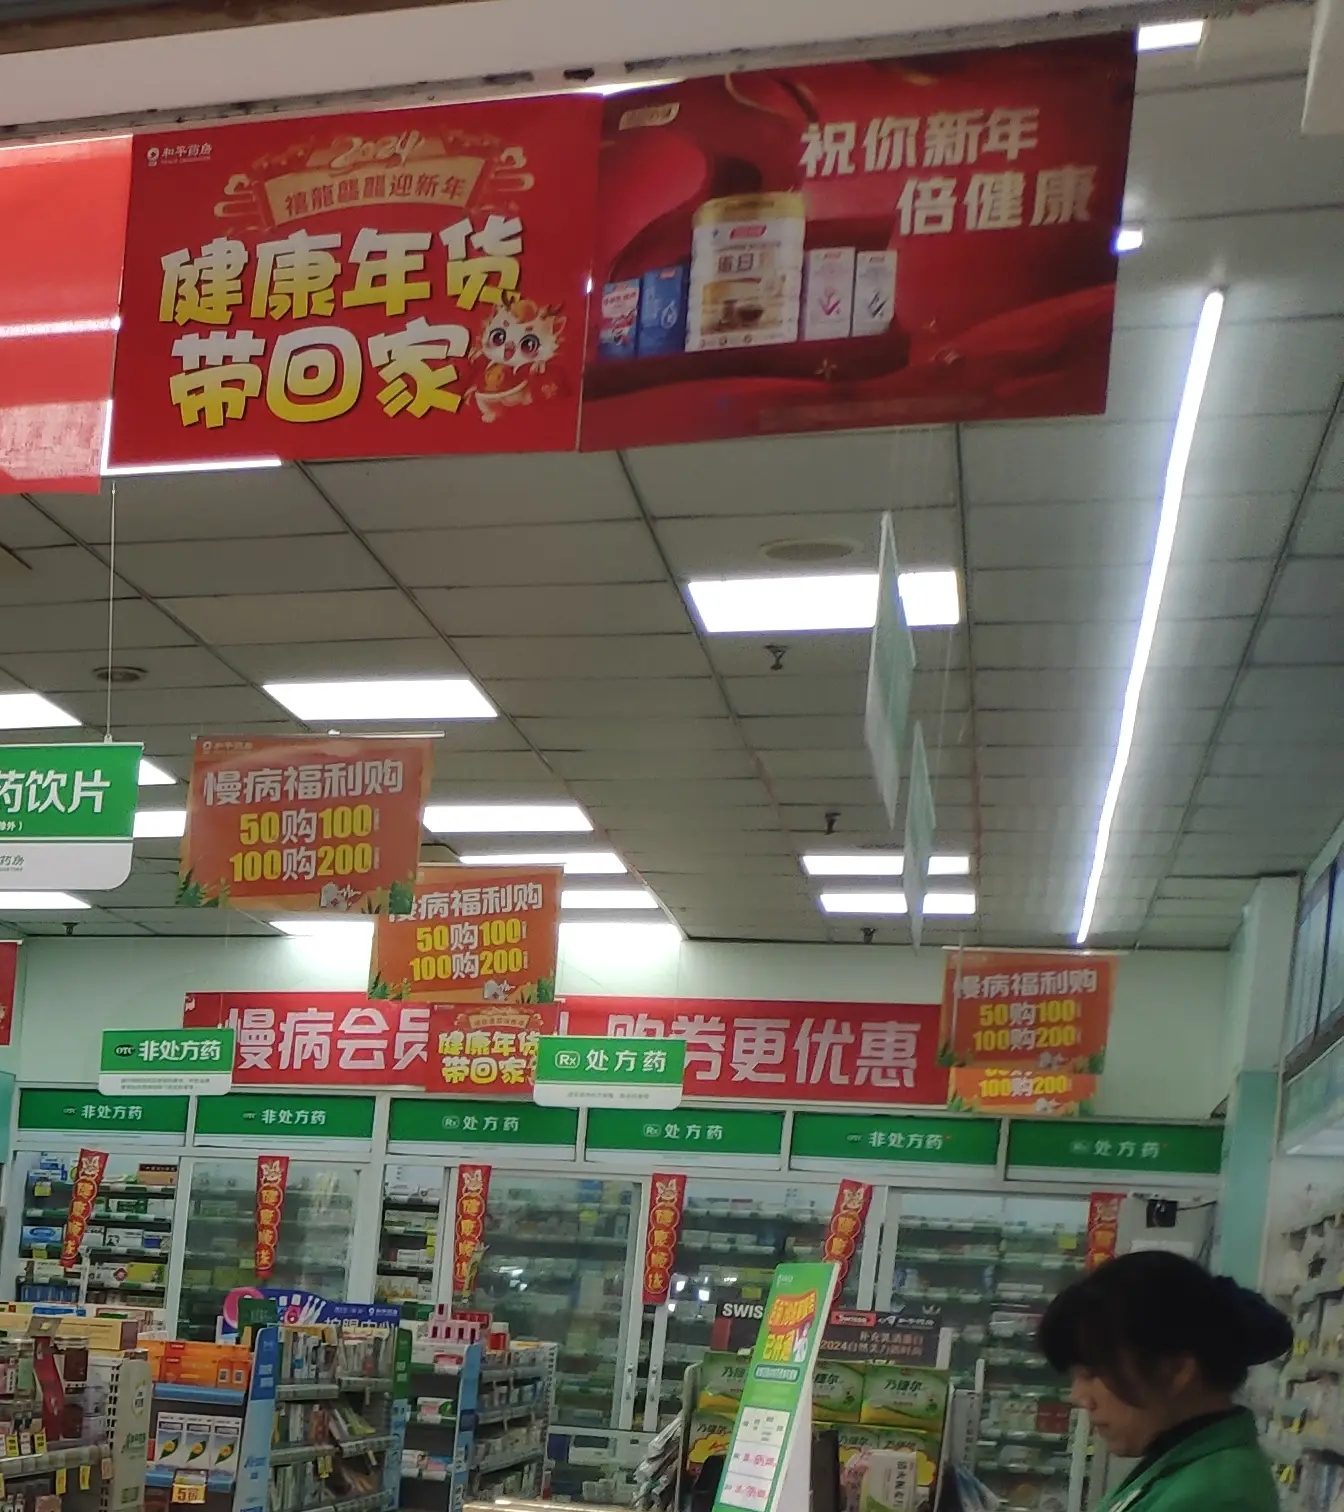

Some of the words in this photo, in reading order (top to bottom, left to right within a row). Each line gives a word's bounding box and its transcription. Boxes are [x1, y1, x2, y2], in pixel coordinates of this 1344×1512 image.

[329, 130, 424, 168] 2024
[799, 106, 1040, 178] 祝你新年
[896, 164, 1098, 237] 倍健康
[158, 213, 525, 327] 健康年货
[169, 316, 471, 429] 带回家
[202, 757, 404, 806] 慢病福利购
[239, 803, 373, 847] 50购100
[229, 842, 373, 884] 100购200
[416, 917, 522, 953] 50购100
[410, 947, 522, 982] 100购200
[979, 1000, 1076, 1027] 50购100
[138, 1039, 221, 1061] 非处方药
[226, 1006, 431, 1071] 慢病会员
[973, 1025, 1076, 1052] 100购200
[441, 1055, 527, 1085] 带回家
[586, 1048, 667, 1072] 处方药
[979, 1075, 1068, 1098] 100购200
[81, 1104, 143, 1120] 非处方药
[261, 1109, 327, 1125] 非处方药
[462, 1115, 520, 1132] 处方药
[663, 1123, 724, 1142] 处方药
[868, 1131, 944, 1150] 非处方药
[1093, 1140, 1160, 1160] 处方药
